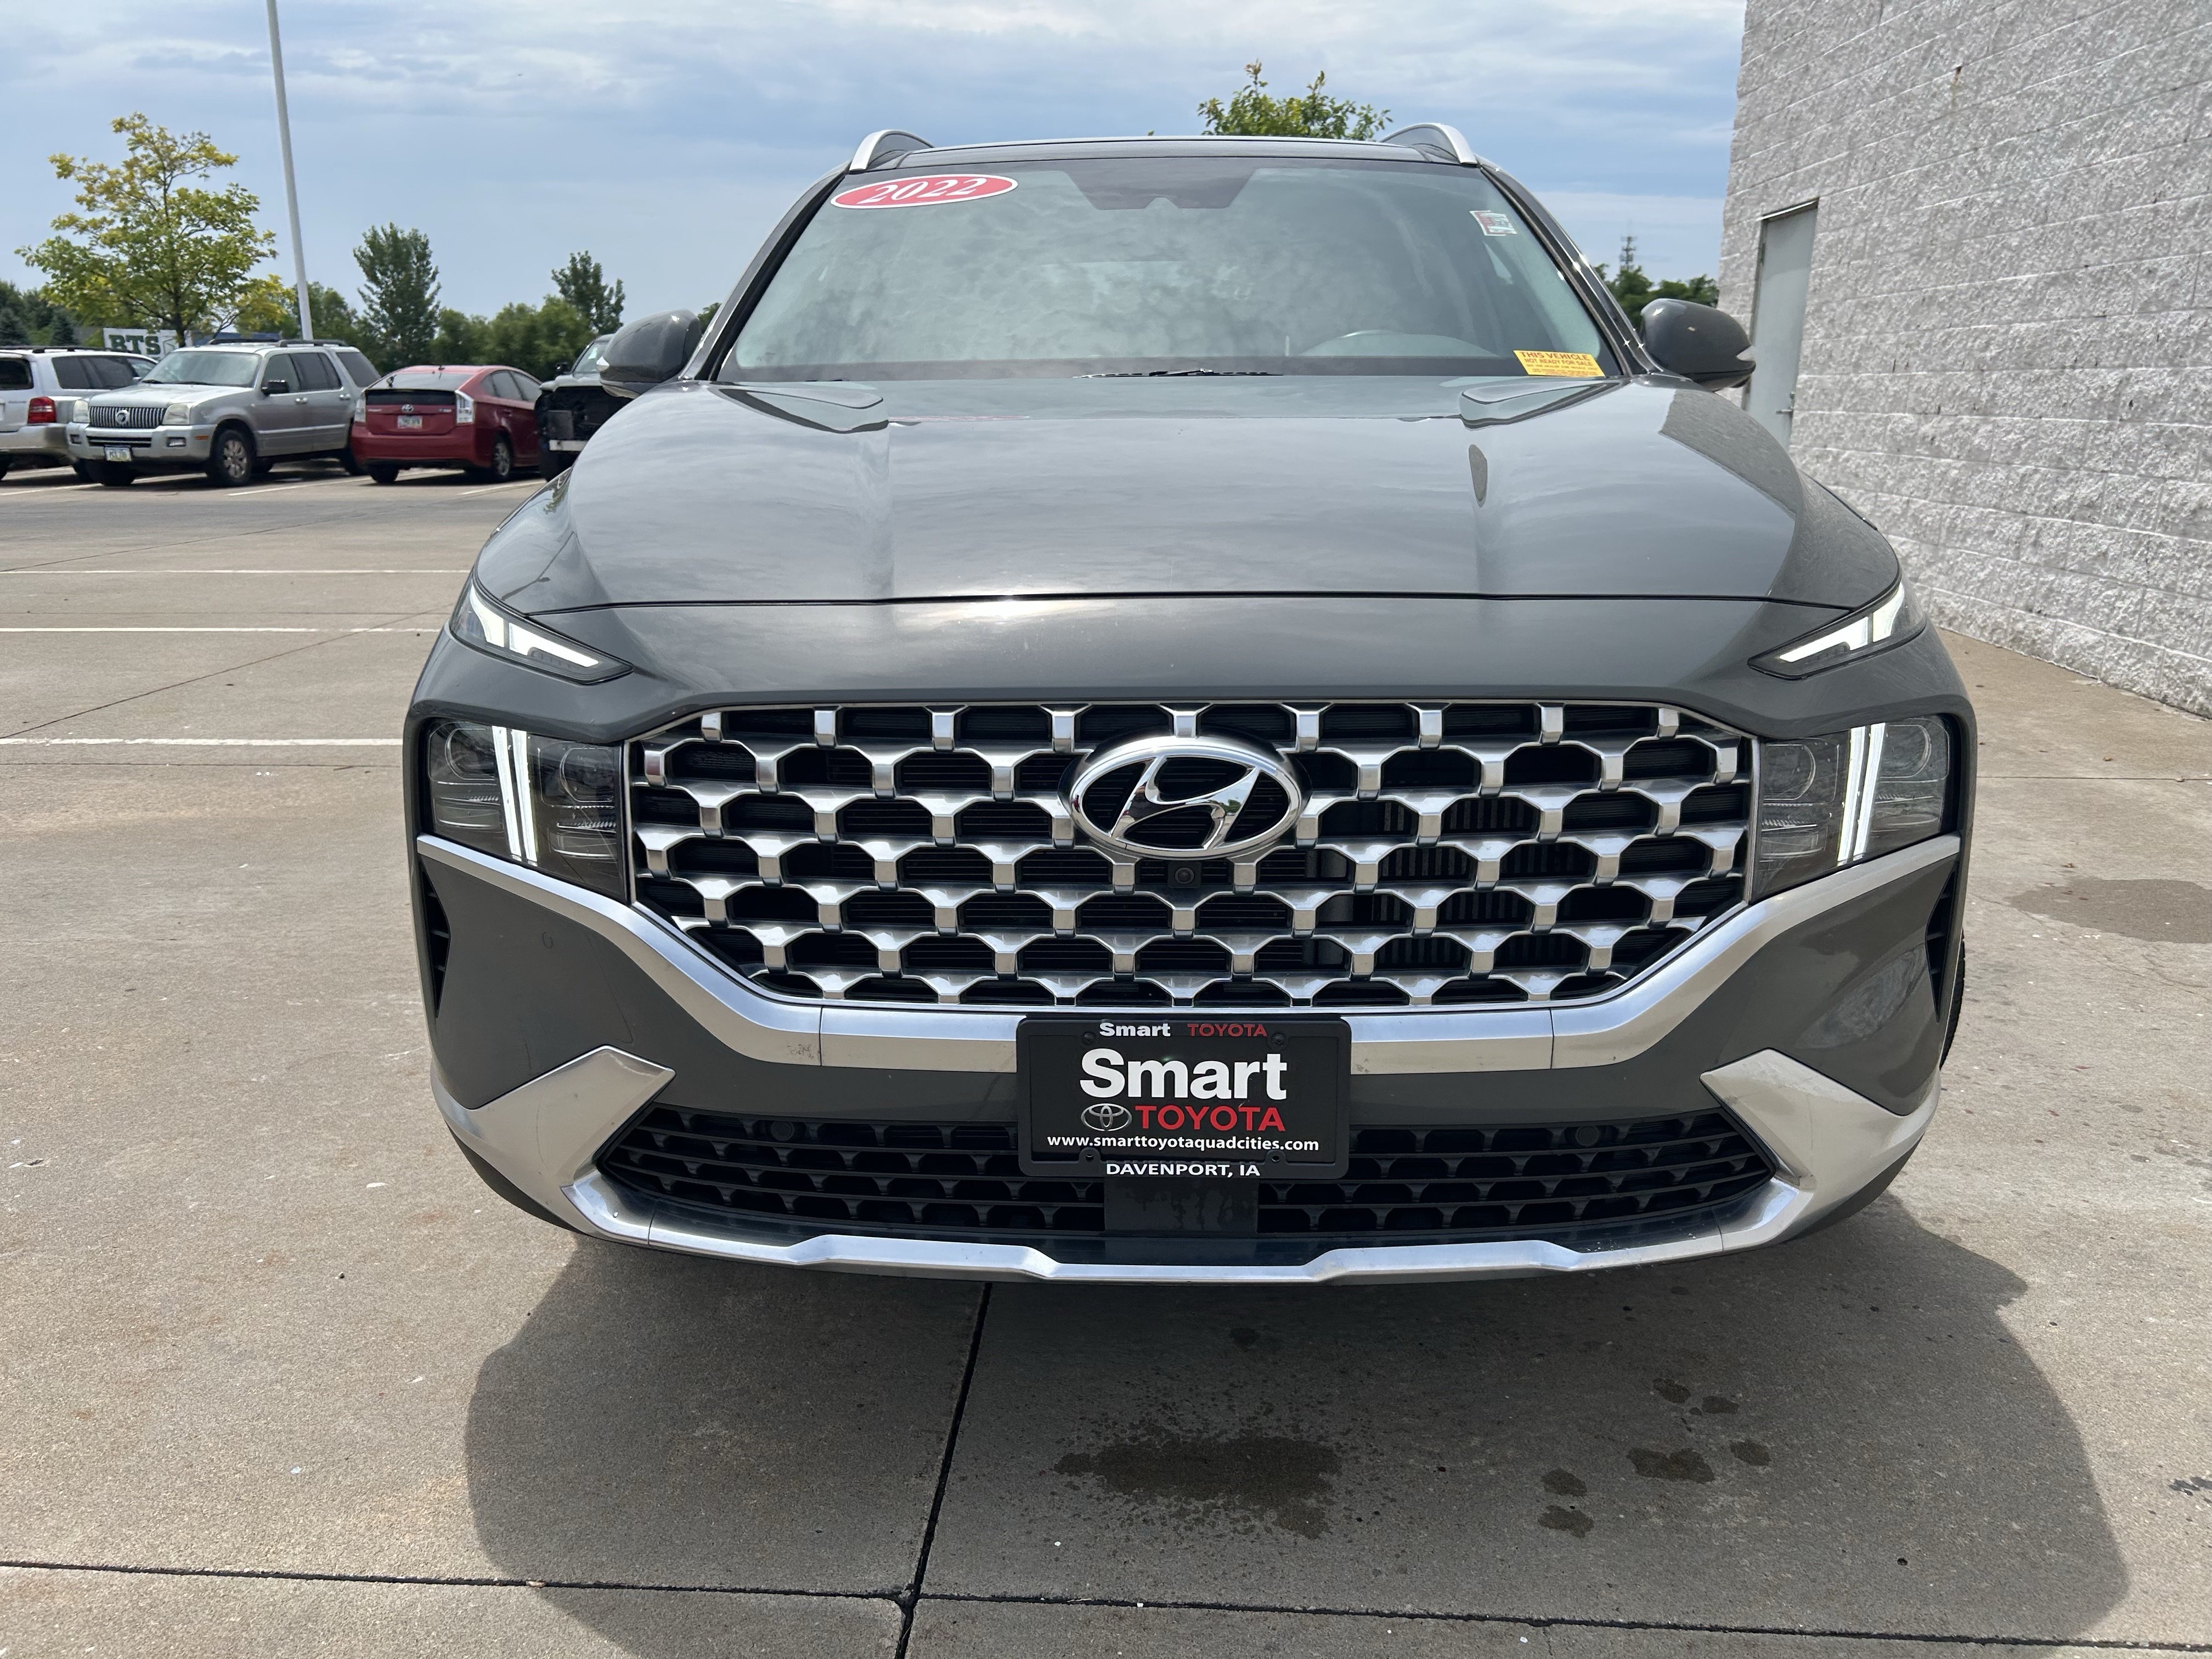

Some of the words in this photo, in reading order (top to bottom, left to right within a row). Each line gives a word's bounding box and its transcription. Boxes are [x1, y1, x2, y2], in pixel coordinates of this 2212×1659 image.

[856, 178, 988, 205] 2022
[1099, 1022, 1171, 1037] Smart
[1187, 1023, 1267, 1037] TOYOTA
[1080, 1048, 1287, 1100] Smart
[1135, 1104, 1286, 1132] TOYOTA
[1047, 1134, 1319, 1152] www.smarttoyotaquadcities.com
[1106, 1163, 1234, 1178] DAVENPORT,
[1239, 1164, 1261, 1177] IA
